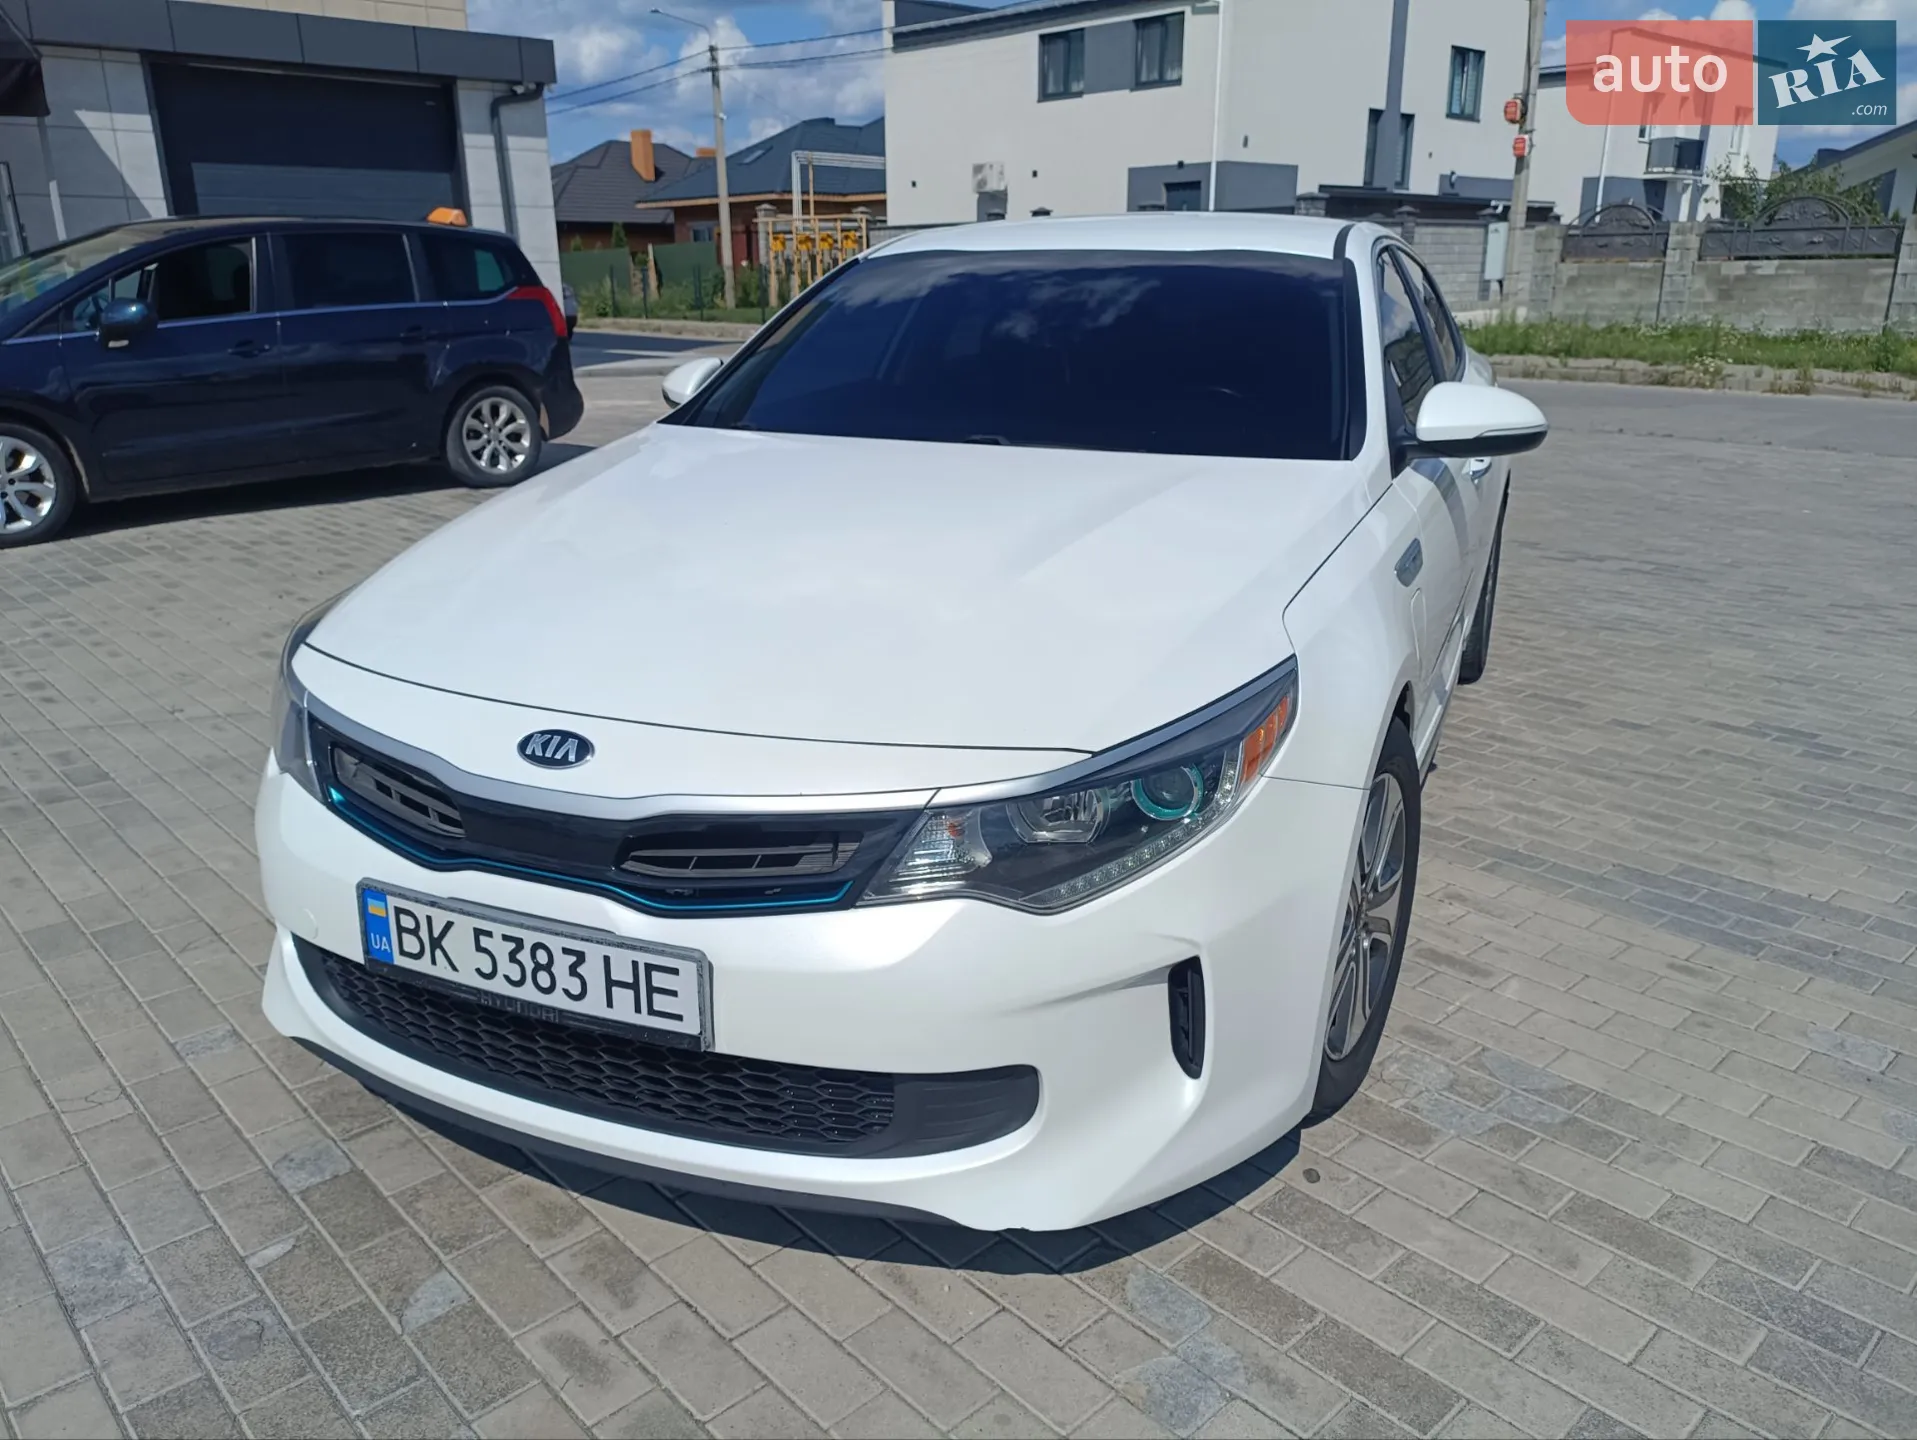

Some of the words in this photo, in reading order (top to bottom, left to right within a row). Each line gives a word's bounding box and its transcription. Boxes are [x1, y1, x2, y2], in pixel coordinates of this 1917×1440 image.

[525, 733, 579, 763] KIA
[371, 932, 391, 953] UA
[394, 905, 460, 973] BK
[473, 926, 589, 1002] 5383
[602, 954, 685, 1022] HE
